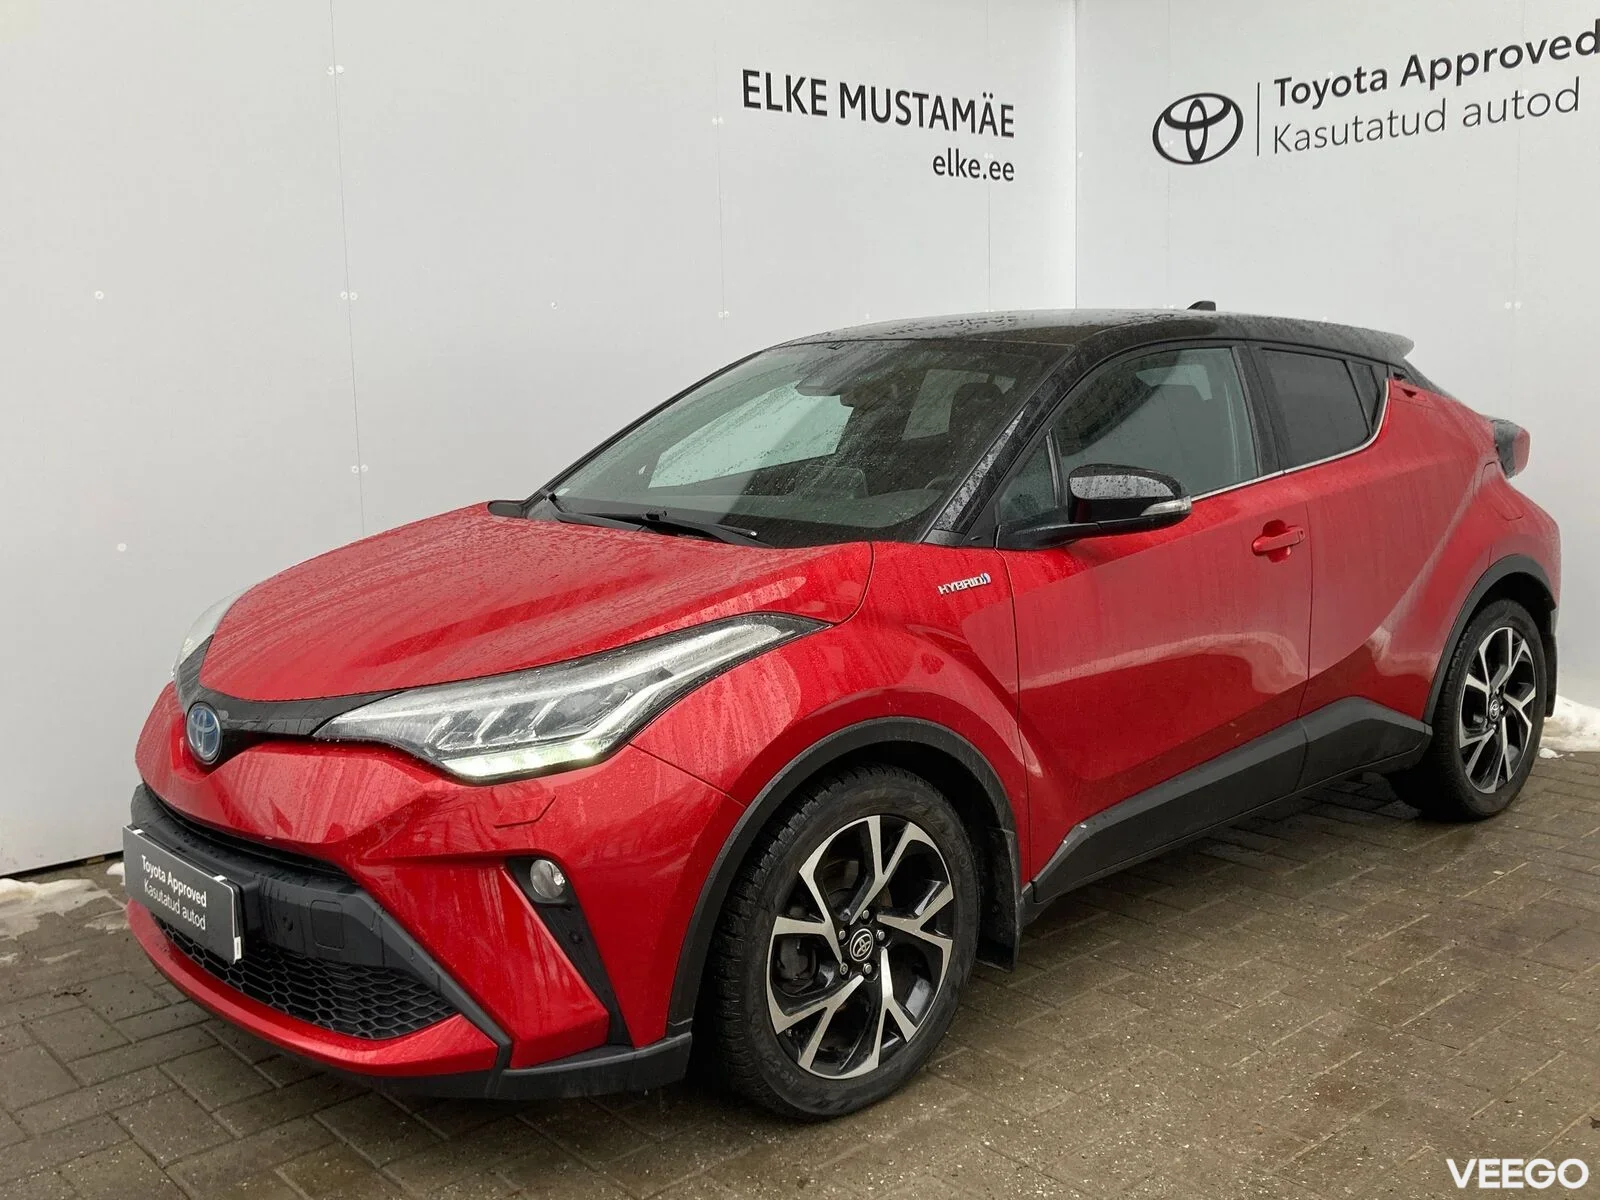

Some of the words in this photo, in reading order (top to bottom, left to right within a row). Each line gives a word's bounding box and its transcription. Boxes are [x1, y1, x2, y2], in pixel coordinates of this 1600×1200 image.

[1273, 66, 1389, 110] Toyota
[1400, 18, 1600, 91] Approved
[742, 69, 829, 117] ELKE
[839, 81, 1015, 138] MUSTAMÄE
[1272, 97, 1447, 154] Kasutatud
[1462, 76, 1581, 128] autod
[932, 147, 1015, 181] elke.ee
[937, 576, 984, 595] HYBRID
[141, 854, 166, 882] Toyota
[167, 871, 207, 908] Approved
[143, 878, 181, 914] Kasutatud
[182, 905, 206, 930] autod
